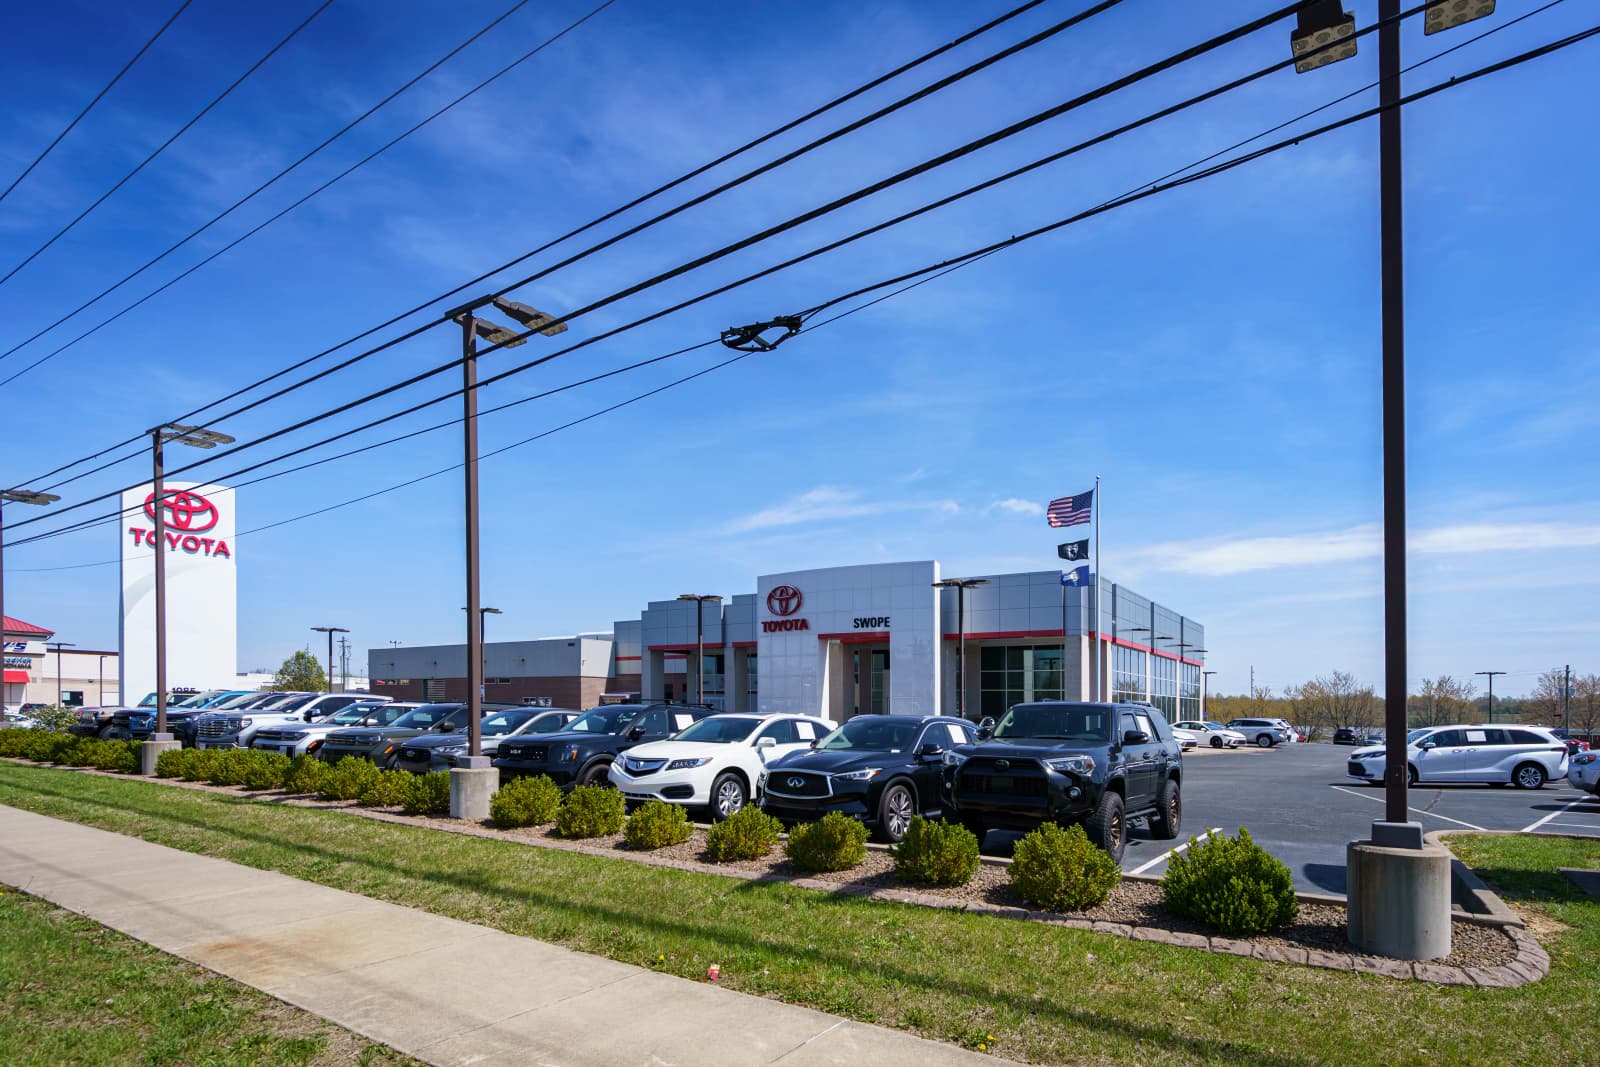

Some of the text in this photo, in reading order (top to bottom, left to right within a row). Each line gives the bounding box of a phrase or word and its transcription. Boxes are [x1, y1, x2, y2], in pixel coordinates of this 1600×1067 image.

[129, 527, 231, 557] TOYOTA
[761, 619, 809, 632] TOYOTA
[853, 616, 891, 629] SWOPE
